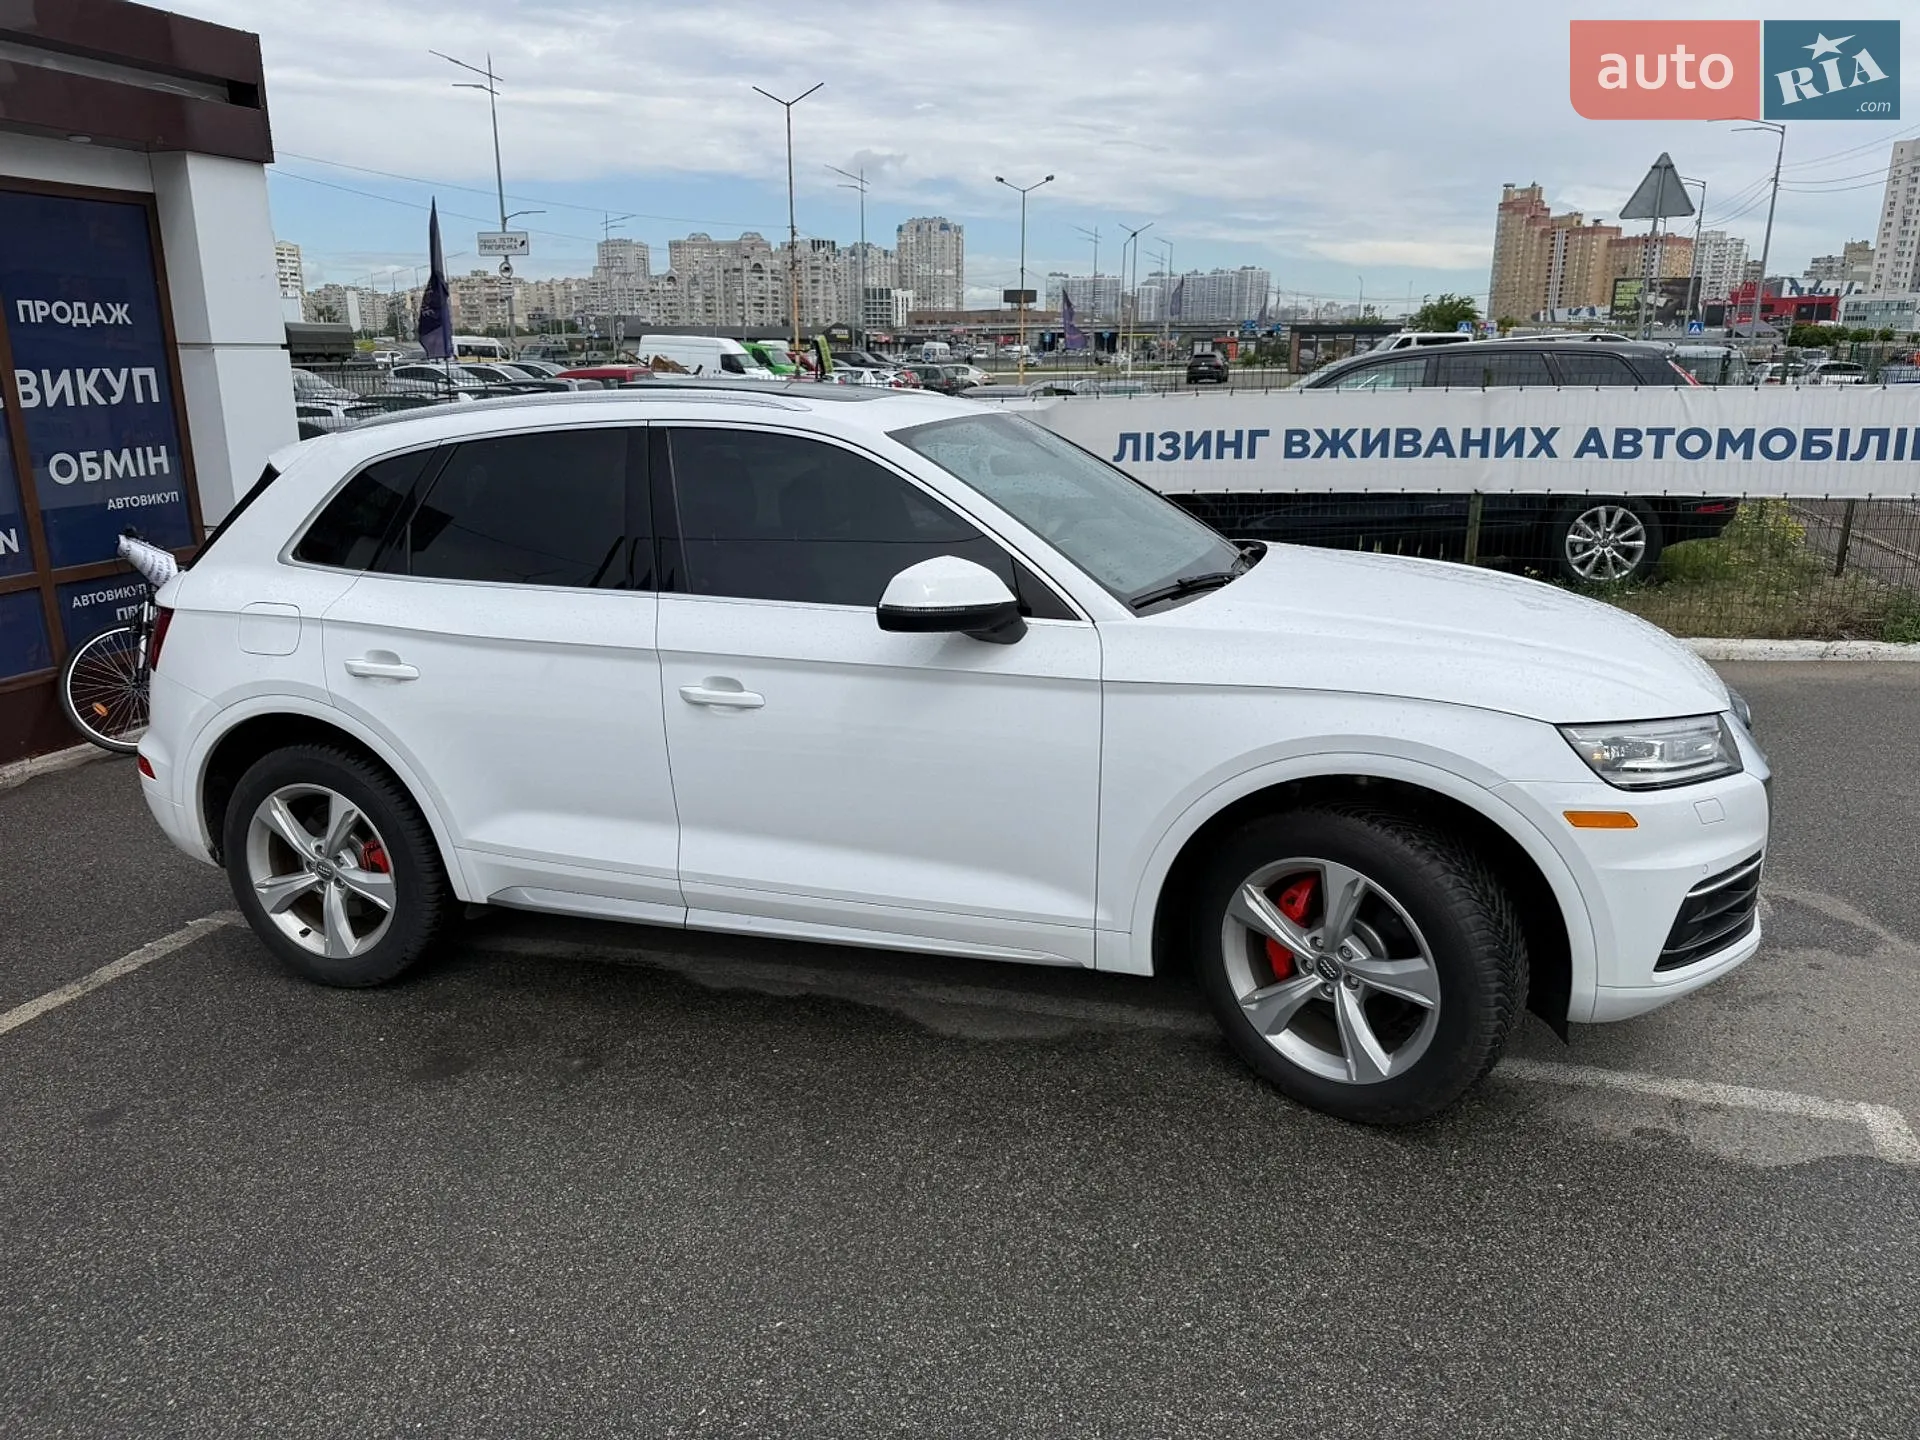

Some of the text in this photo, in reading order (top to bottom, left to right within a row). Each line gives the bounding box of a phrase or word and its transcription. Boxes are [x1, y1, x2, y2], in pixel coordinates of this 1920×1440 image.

[16, 299, 133, 328] ПРОДАЖ
[14, 366, 160, 409] ВИКУП
[1112, 426, 1920, 463] ЛІЗИНГ ВЖИВАНИХ АВТОМОБІЛІ
[48, 445, 170, 486] ОБМІН
[107, 490, 180, 511] АВТОВИКУП
[72, 583, 147, 609] АВТОВИКУП
